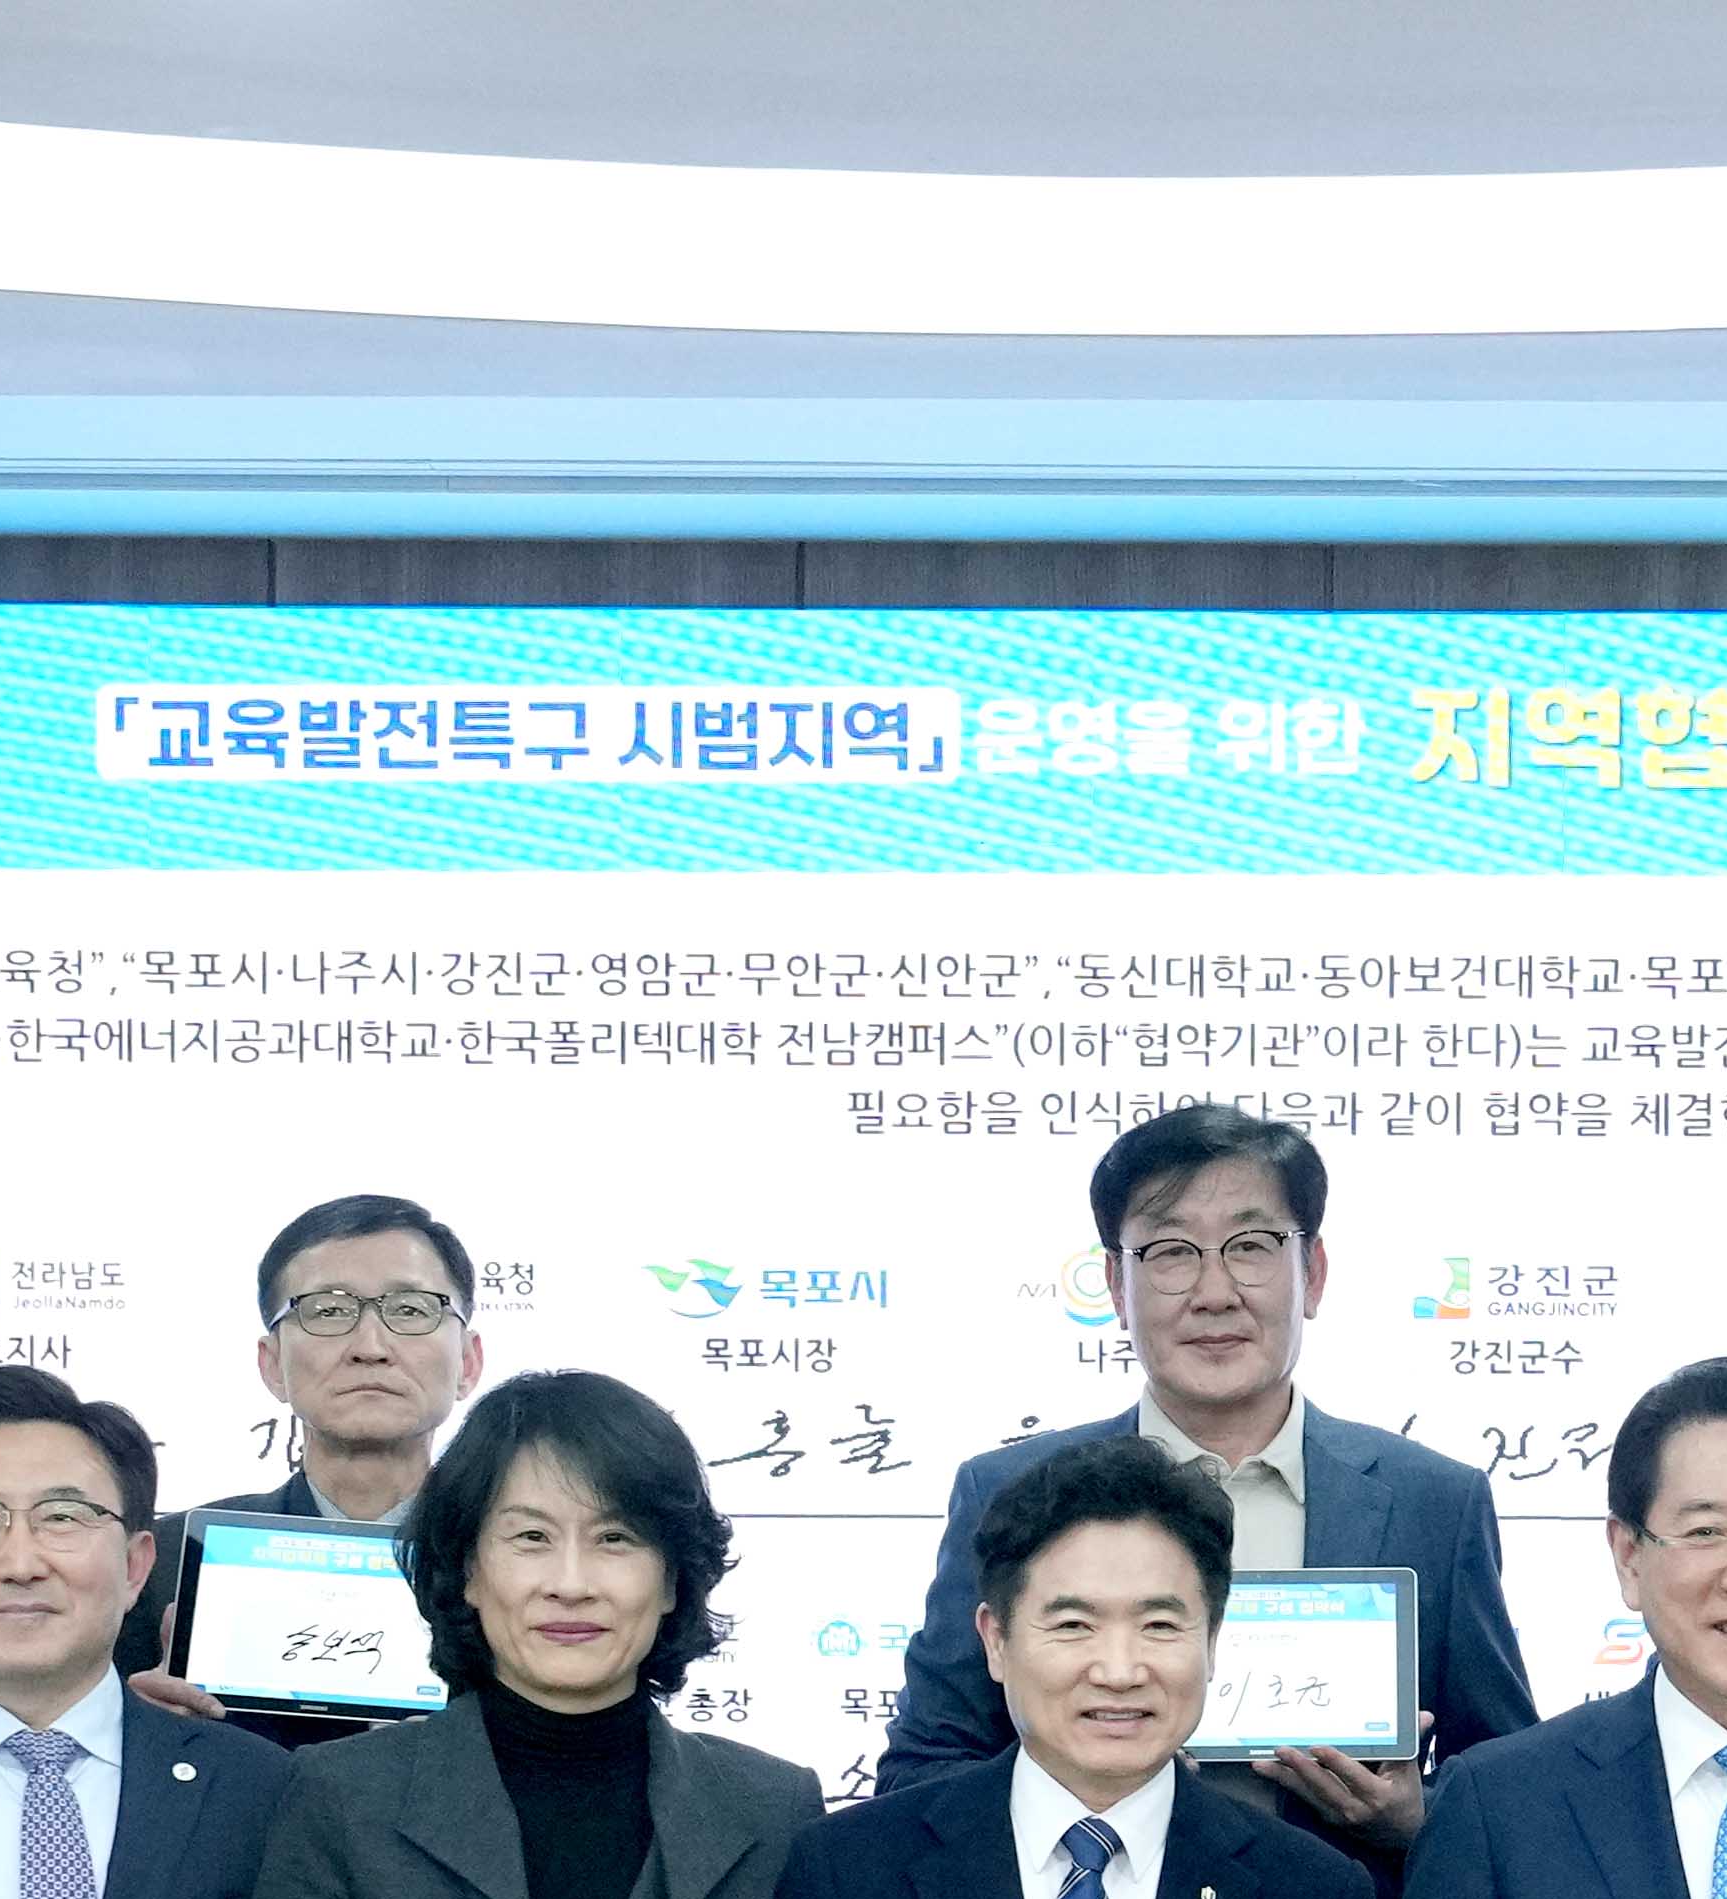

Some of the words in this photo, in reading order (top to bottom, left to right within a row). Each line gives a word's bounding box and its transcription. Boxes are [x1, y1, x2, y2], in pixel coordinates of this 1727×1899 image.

[976, 698, 1192, 776] 운영을
[1216, 698, 1366, 776] 위한
[1423, 1023, 1567, 1069] 한다)는
[848, 1090, 1023, 1135] 필요함을
[1380, 1091, 1461, 1136] 같이
[1483, 1091, 1612, 1137] 협약을
[12, 1261, 125, 1290] 전라남도
[760, 1269, 888, 1309] 목포시
[1488, 1264, 1618, 1298] 강진군
[701, 1337, 838, 1374] 목포시장
[1450, 1339, 1584, 1375] 강진군수
